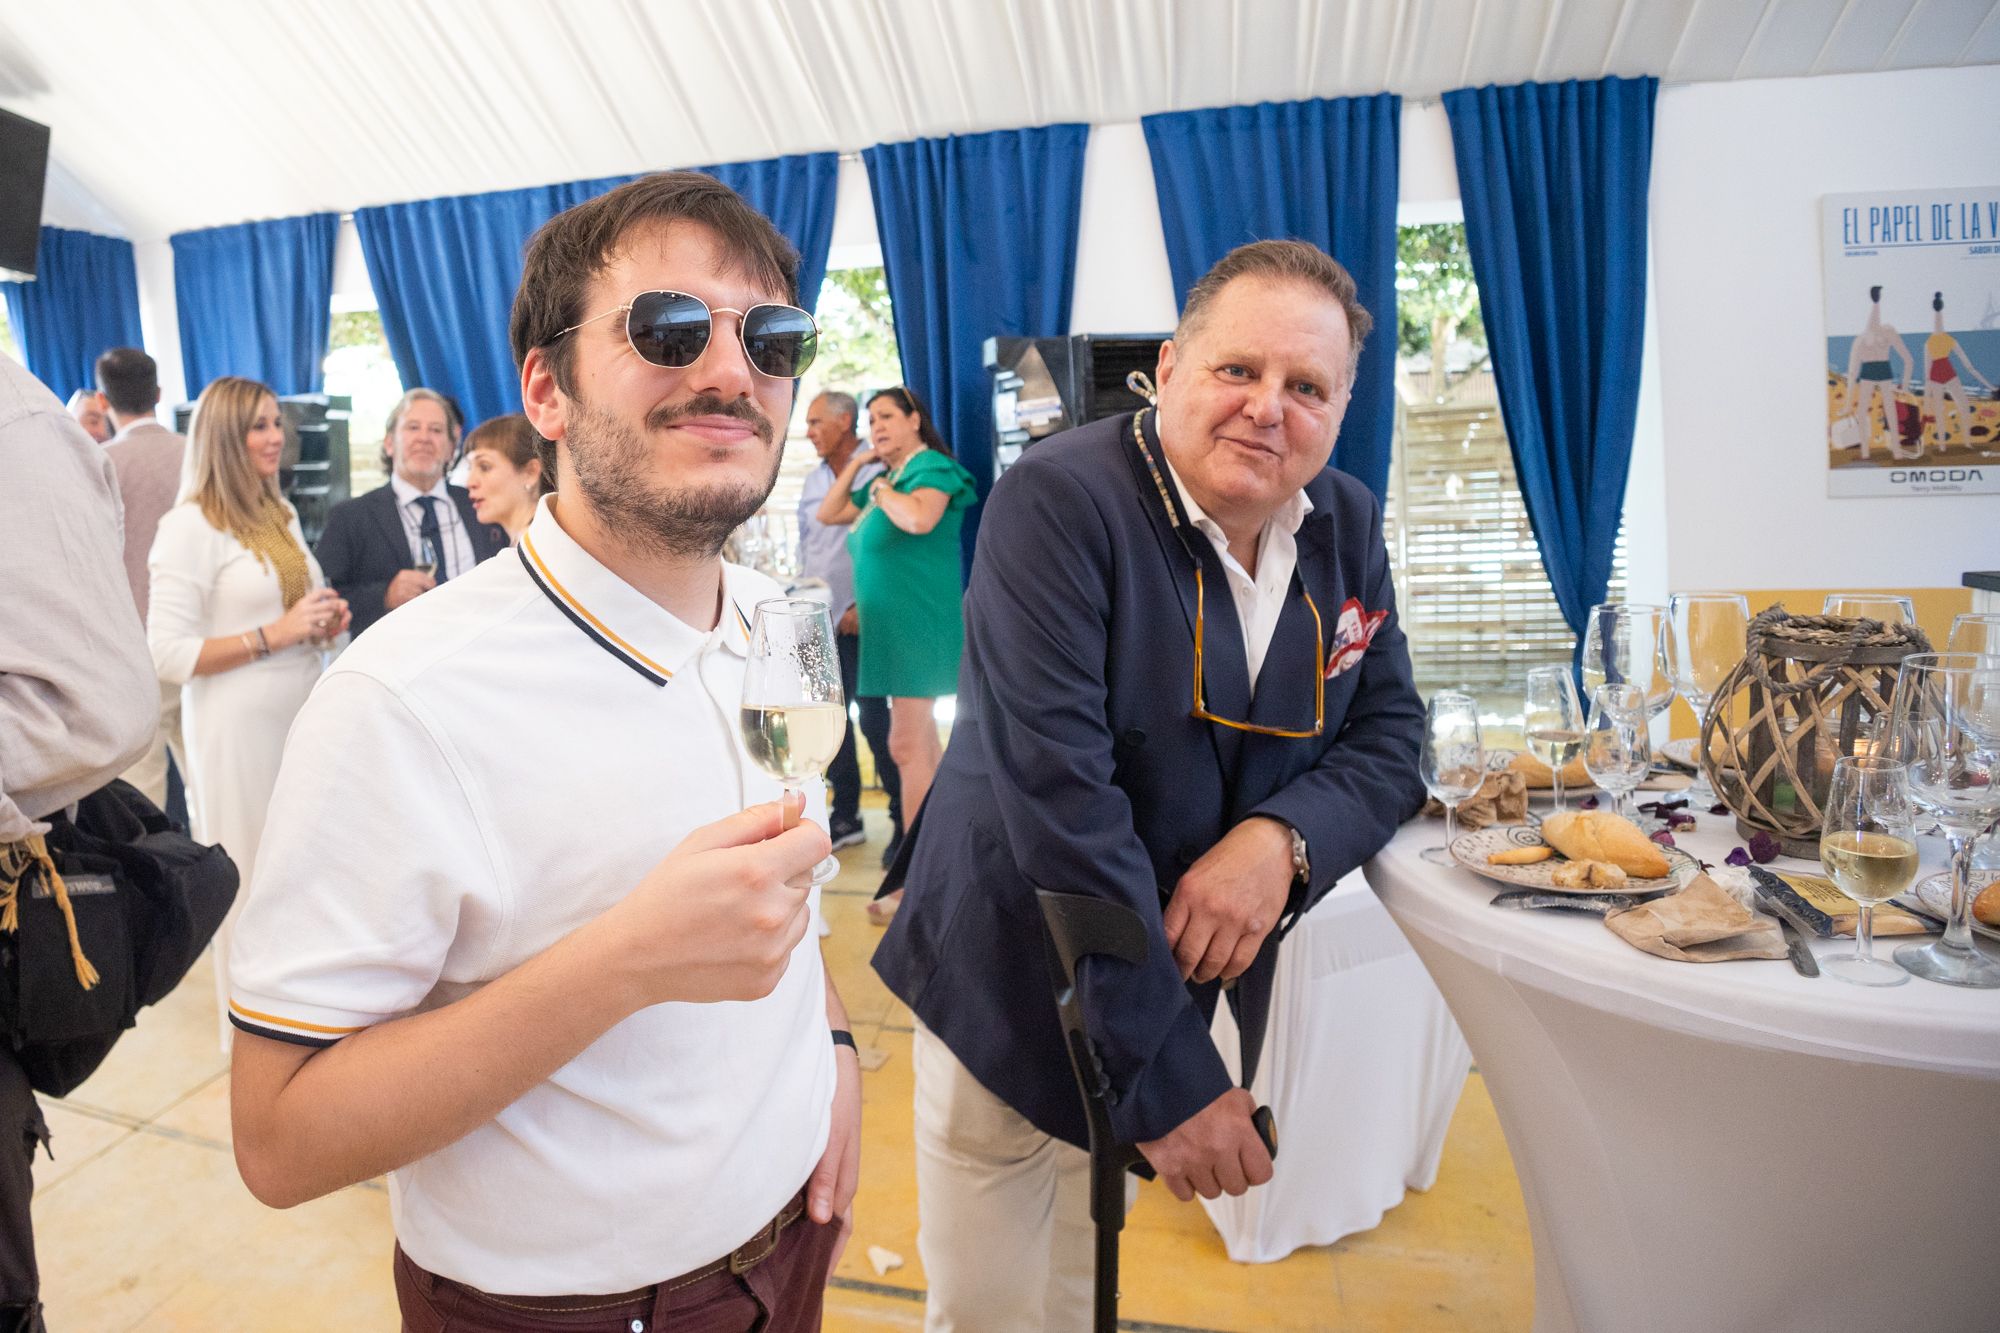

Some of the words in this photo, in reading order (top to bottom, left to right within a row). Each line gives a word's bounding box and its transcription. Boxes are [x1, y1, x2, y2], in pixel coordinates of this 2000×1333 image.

[1844, 208, 1860, 244] EL
[1870, 205, 1922, 243] PAPEL
[1932, 203, 1953, 240] DE
[1961, 202, 1981, 239] LA
